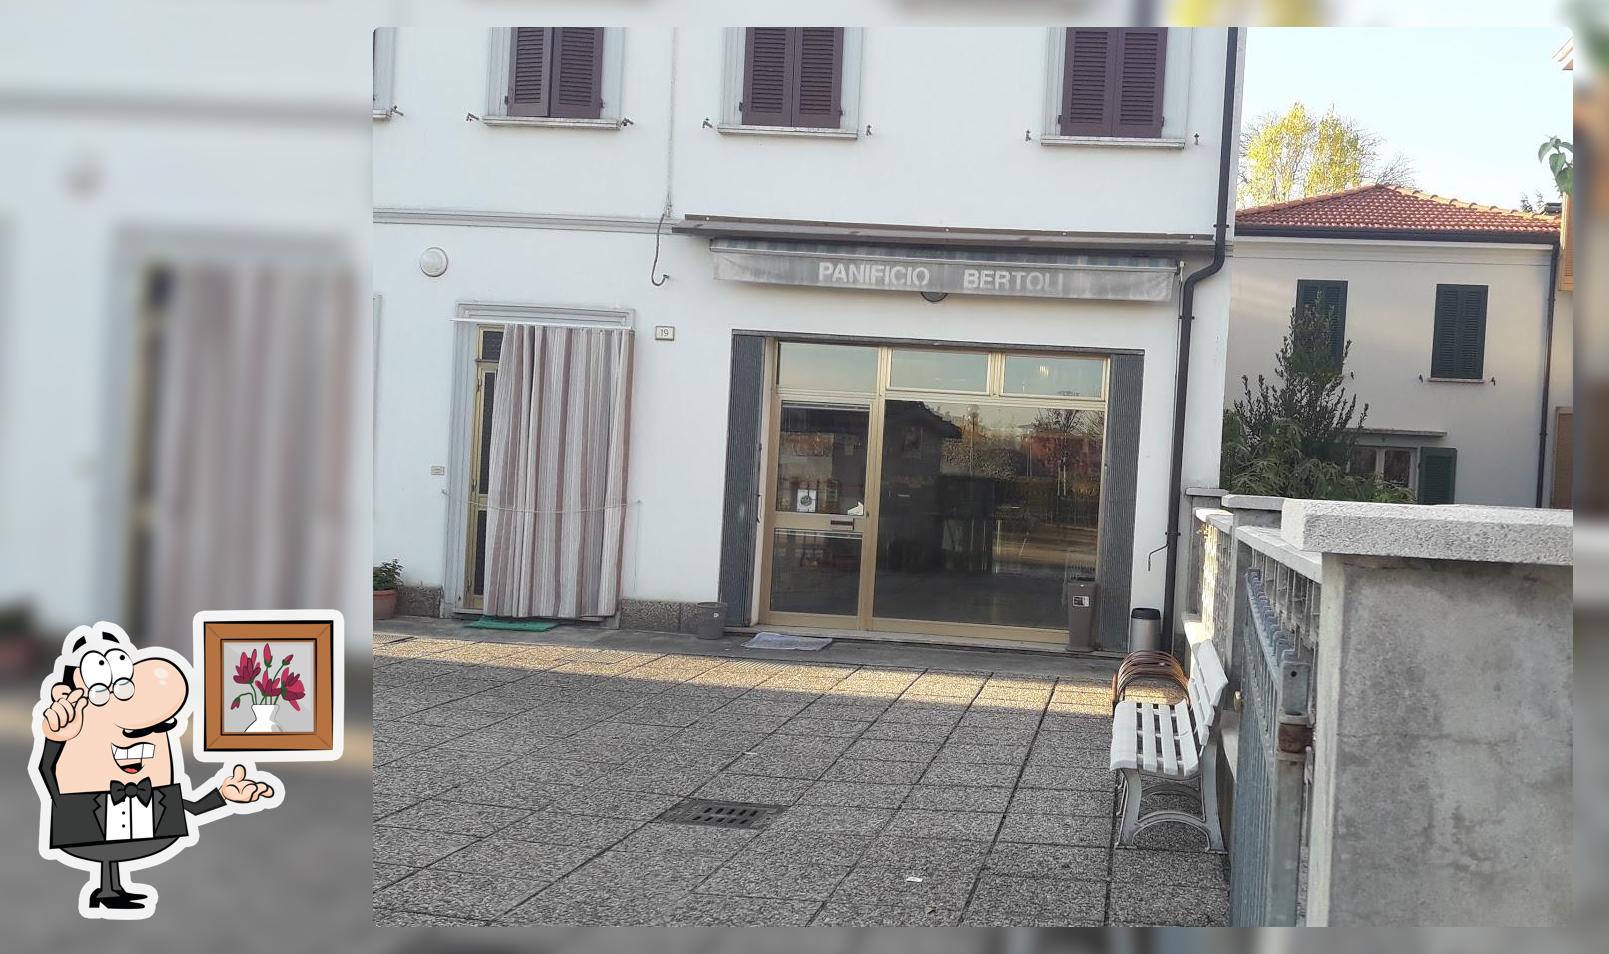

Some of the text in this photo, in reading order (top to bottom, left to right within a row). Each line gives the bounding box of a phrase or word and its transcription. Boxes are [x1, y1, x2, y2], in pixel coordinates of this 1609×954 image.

[818, 262, 1064, 291] PANIFICIO BERTOLI
[660, 328, 669, 337] 19
